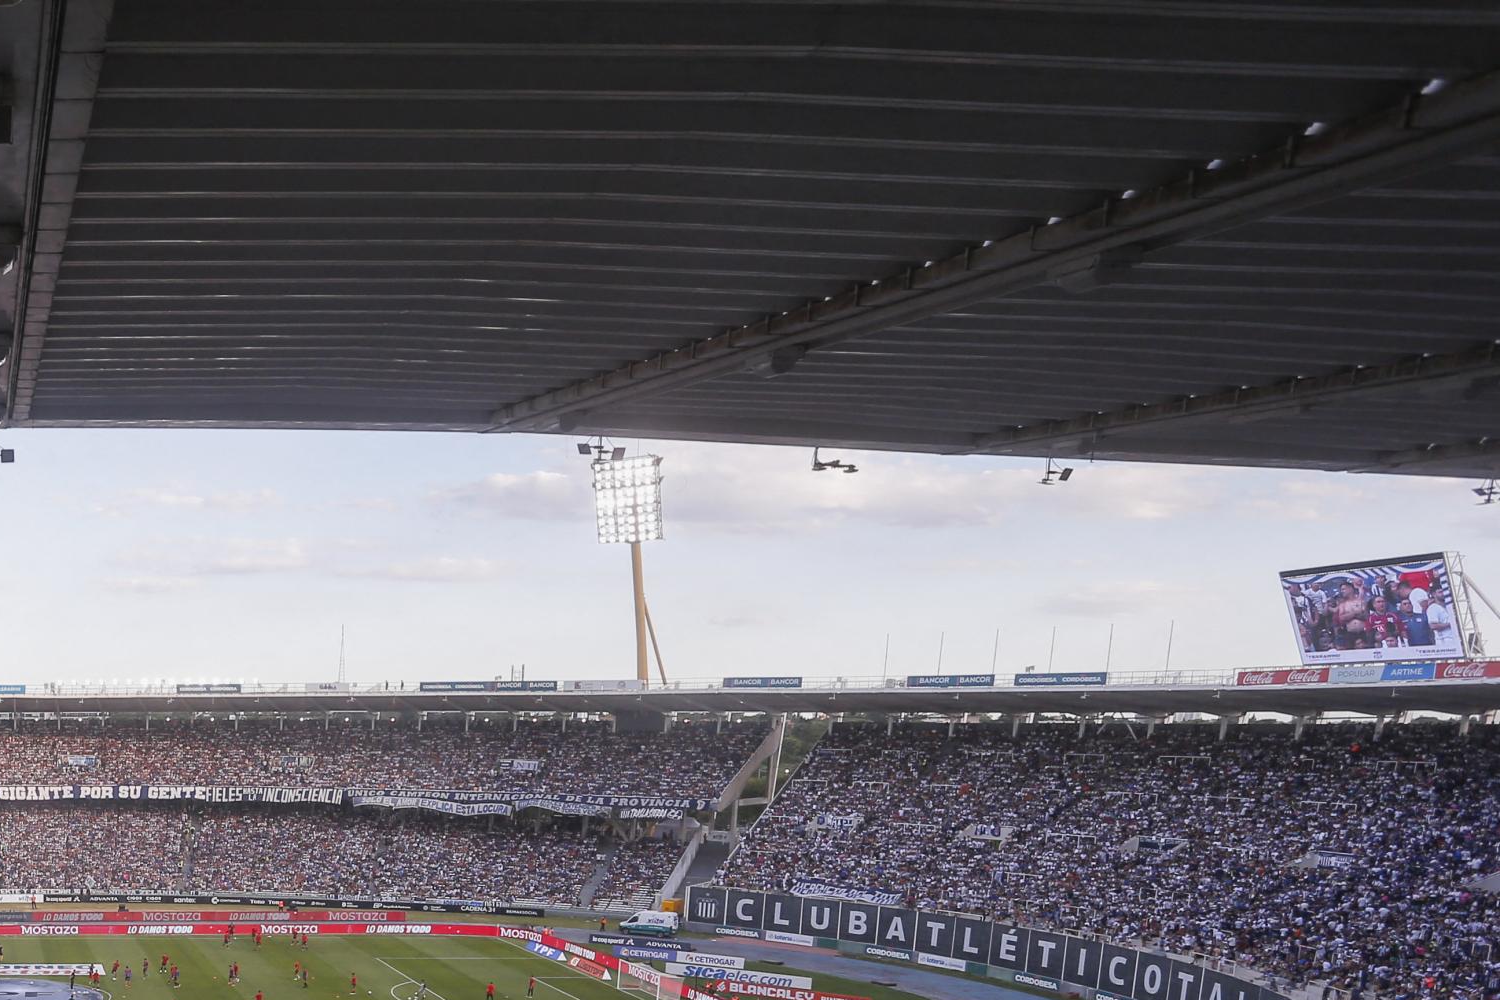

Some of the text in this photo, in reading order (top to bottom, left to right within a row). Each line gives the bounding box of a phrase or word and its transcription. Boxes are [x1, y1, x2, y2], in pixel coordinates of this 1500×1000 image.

[1338, 668, 1376, 679] POPULAR
[1391, 666, 1424, 676] ARTIME
[734, 678, 761, 686] BANCOR
[771, 678, 799, 686] BANCOR
[919, 676, 949, 684] BANCOR
[80, 786, 115, 799] POR
[118, 786, 142, 799] SU
[148, 786, 205, 800] GENTE
[206, 787, 242, 802] FIELES
[262, 788, 343, 805] INCONSCIENCIA
[588, 796, 604, 804] LA
[610, 797, 691, 808] PROVINCIA
[127, 925, 136, 934] LO
[138, 925, 167, 934] DAMOS
[366, 925, 376, 933] LO
[377, 925, 404, 933] DAMOS
[716, 927, 759, 938] CORDOBESA
[533, 943, 555, 956] YPF
[646, 941, 682, 950] ADVANTA
[630, 950, 668, 960] CETROGAR
[867, 947, 910, 960] CORDOBESA
[694, 956, 735, 966] CETROGAR
[684, 965, 793, 987] sicaelec.com
[1015, 974, 1057, 990] CORDOBESA
